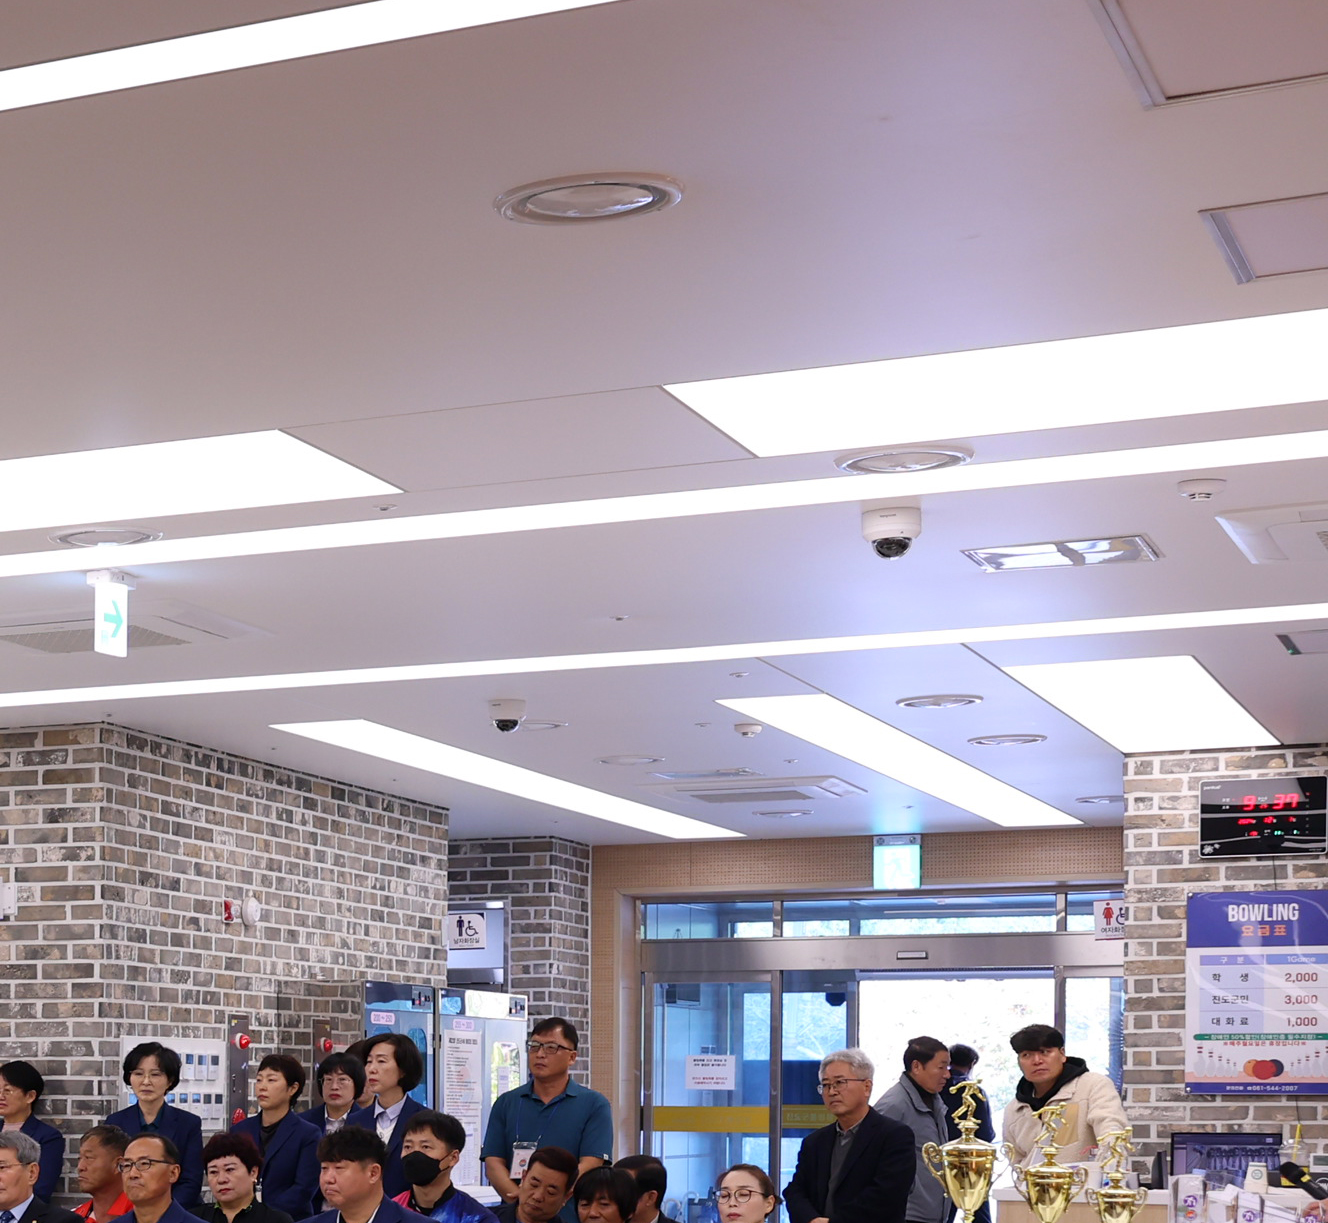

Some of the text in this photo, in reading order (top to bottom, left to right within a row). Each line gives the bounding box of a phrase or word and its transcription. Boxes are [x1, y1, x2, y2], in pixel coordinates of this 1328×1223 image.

[1228, 903, 1299, 922] BOWLING
[1285, 972, 1318, 983] 2,000
[1212, 994, 1249, 1004] 진도군민
[1284, 994, 1318, 1005] 3,000
[1286, 1016, 1318, 1027] 1,000
